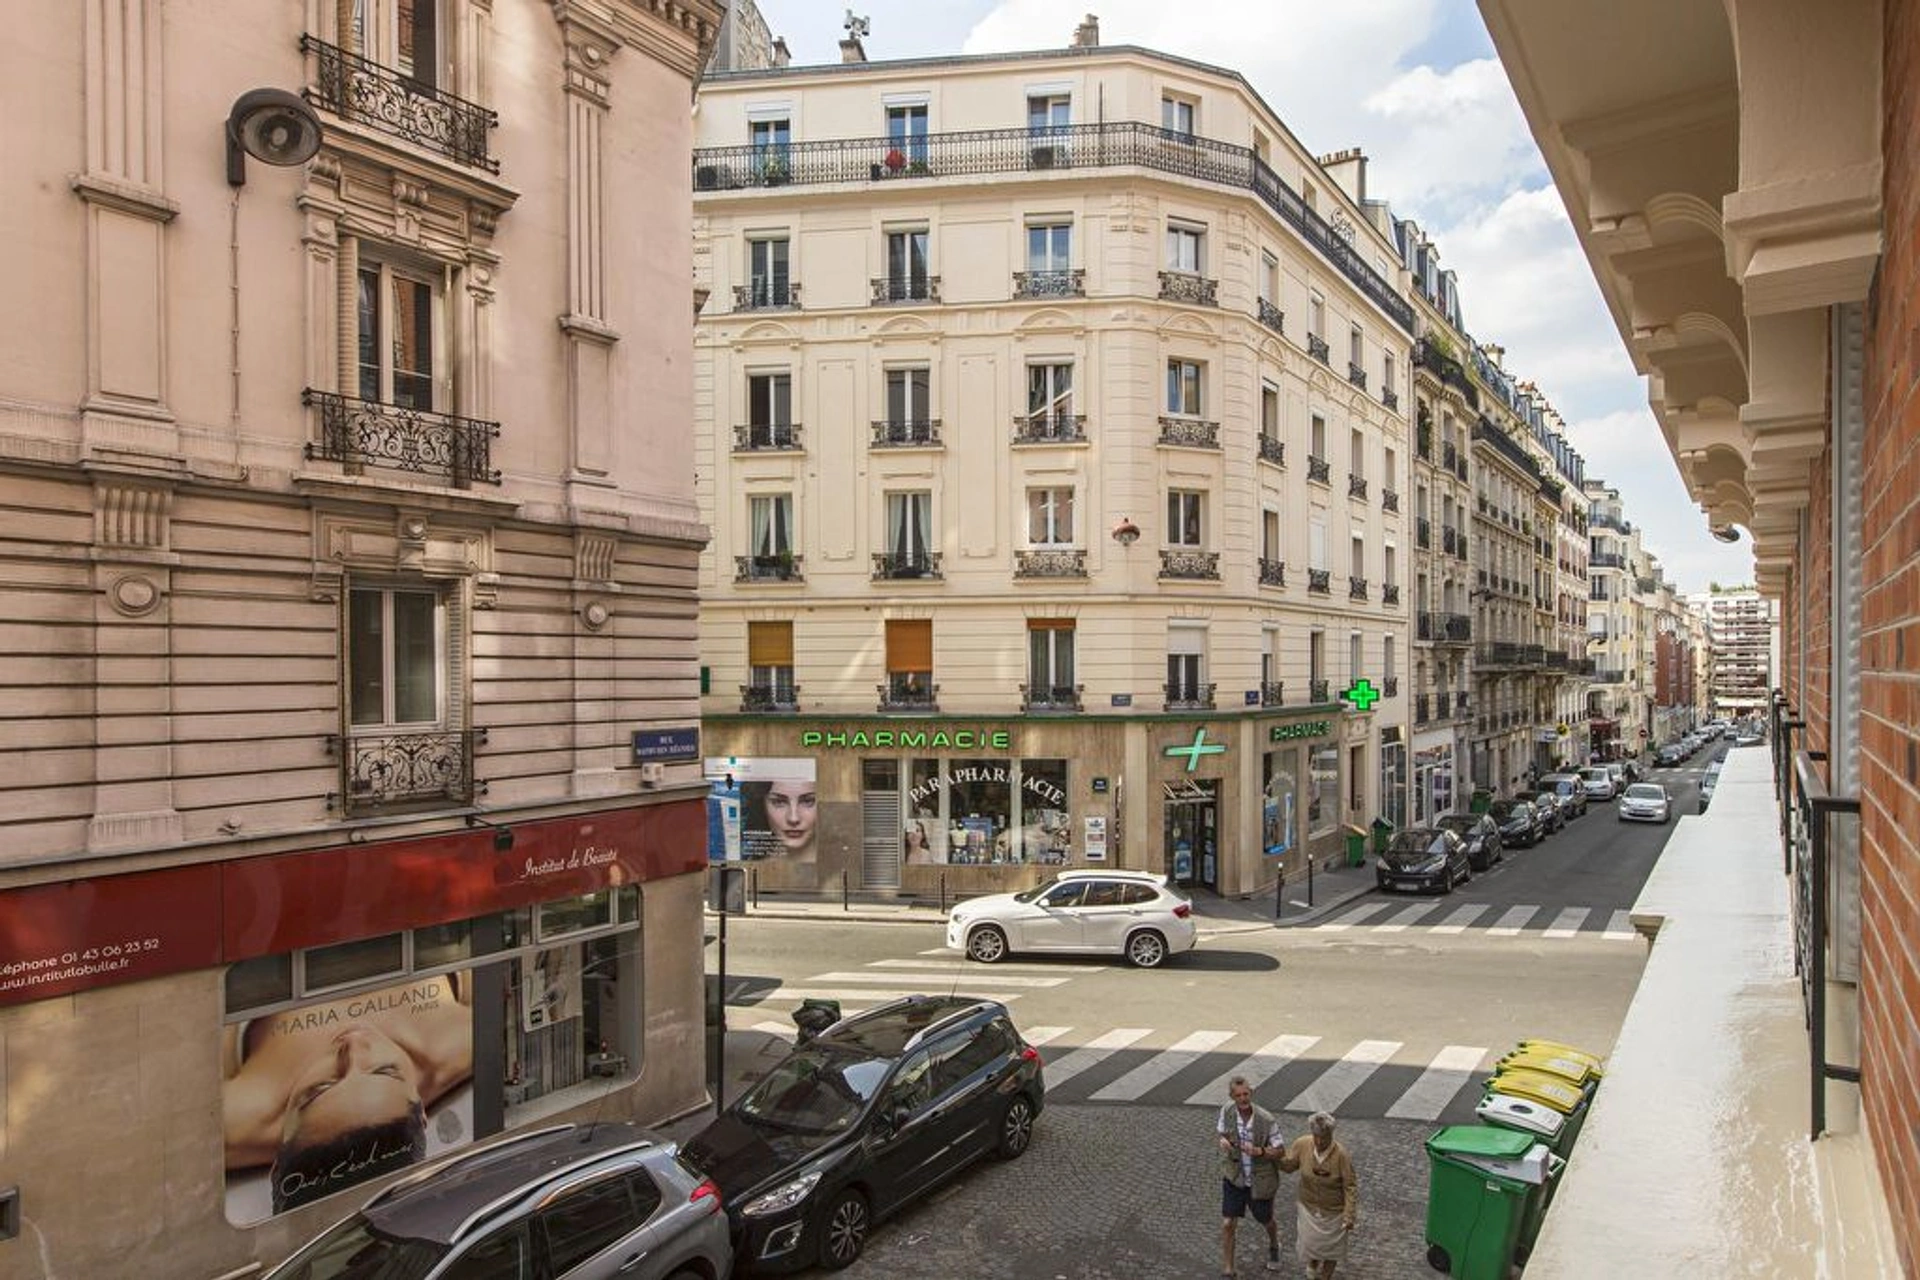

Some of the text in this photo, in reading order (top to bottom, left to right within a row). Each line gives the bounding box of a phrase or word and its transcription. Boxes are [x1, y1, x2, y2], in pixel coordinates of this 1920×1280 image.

[802, 730, 1010, 749] PHARMACIE
[908, 767, 1066, 805] PARAPHARMACIE
[520, 847, 618, 878] Institut de Beauté
[0, 938, 159, 976] éphone 01 43 06 23 52
[272, 983, 441, 1036] MARIA GALLAND
[411, 1000, 440, 1015] PARIS
